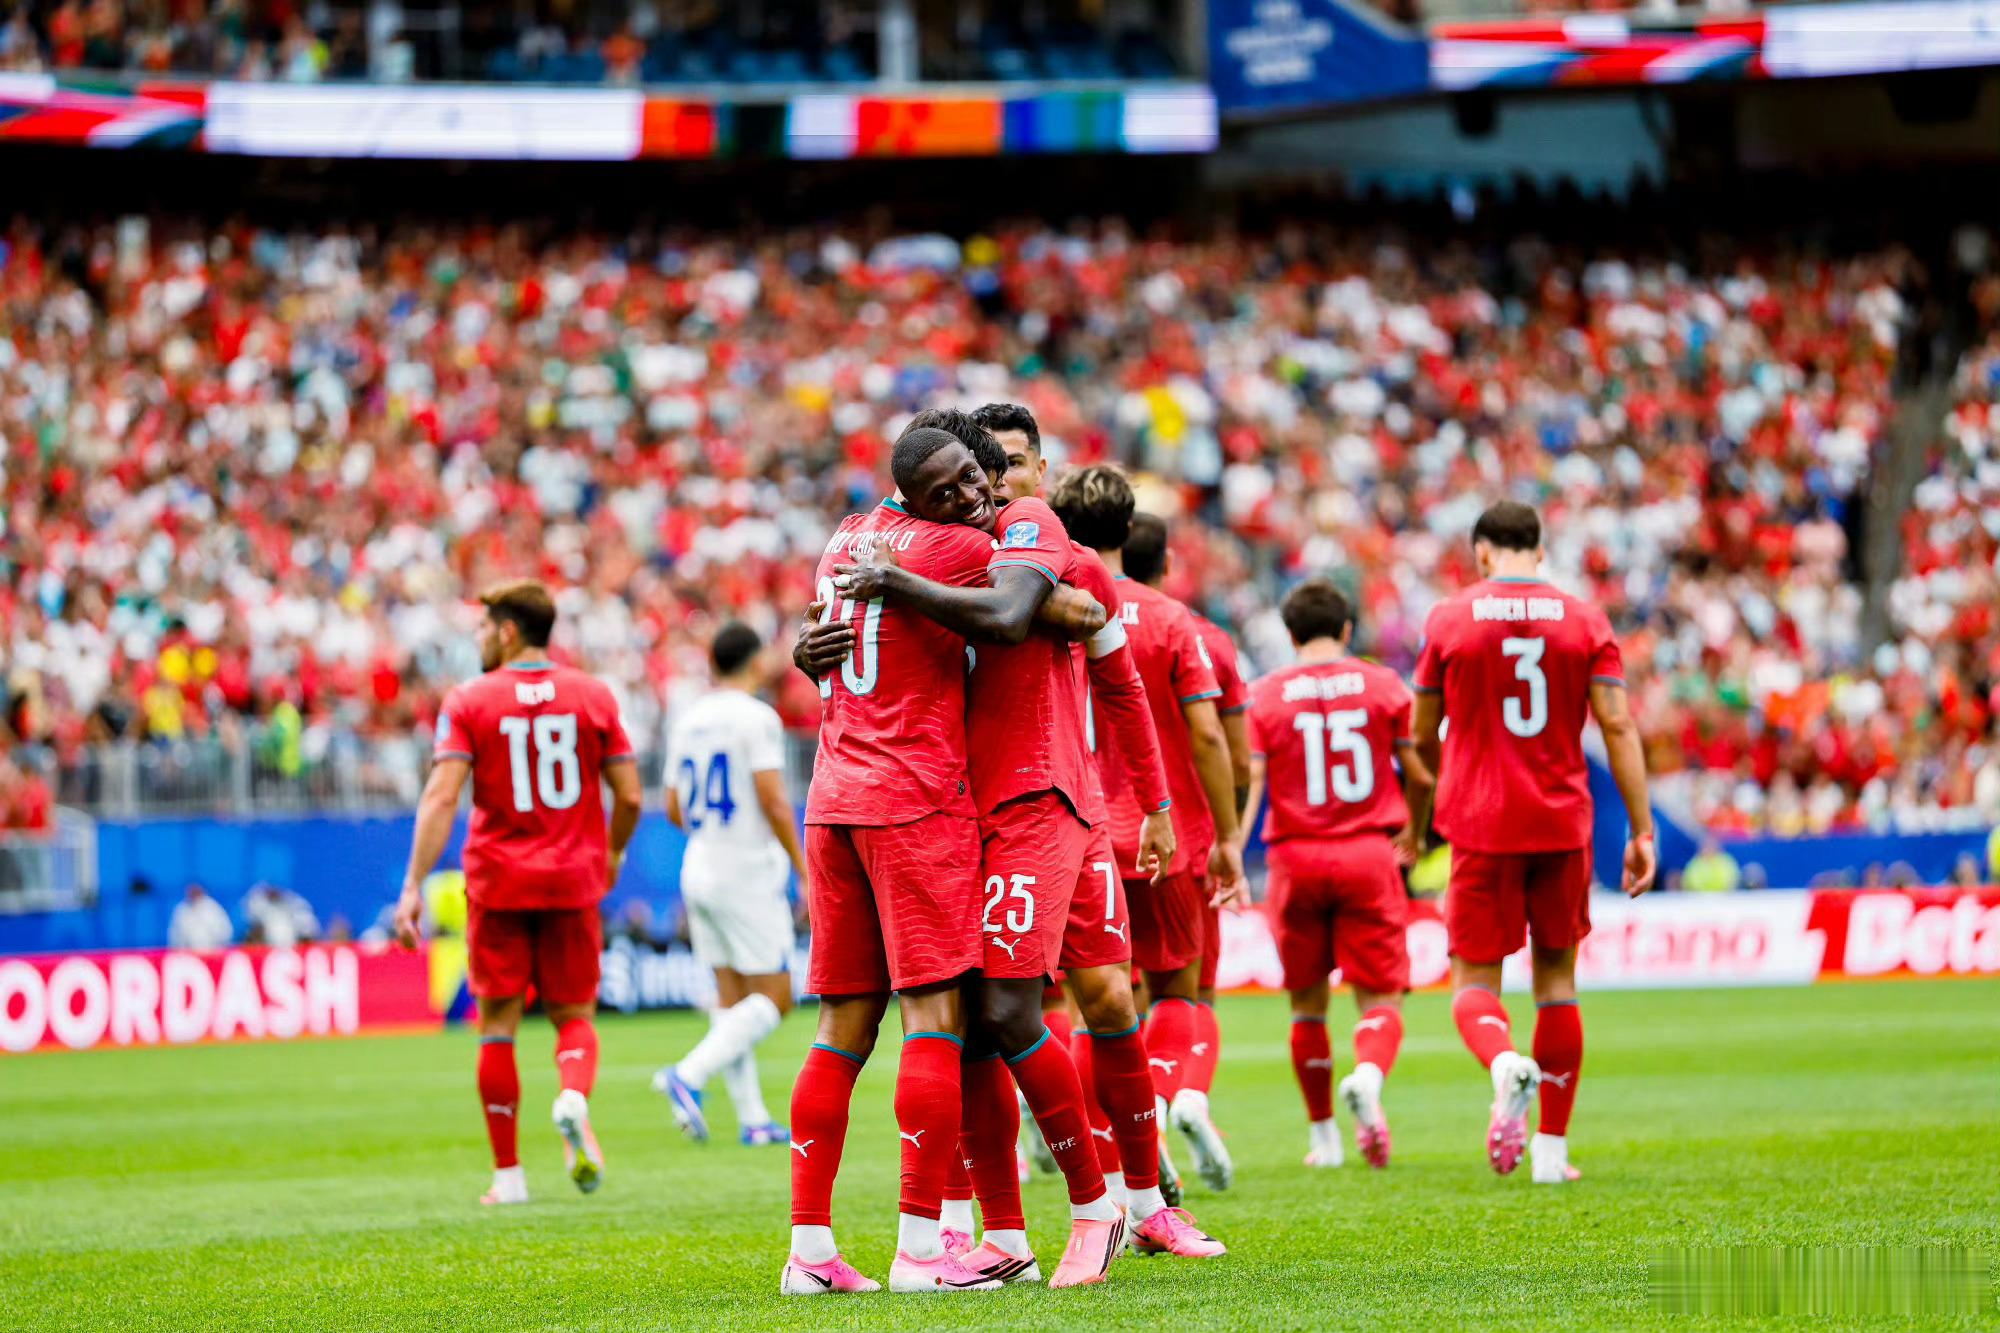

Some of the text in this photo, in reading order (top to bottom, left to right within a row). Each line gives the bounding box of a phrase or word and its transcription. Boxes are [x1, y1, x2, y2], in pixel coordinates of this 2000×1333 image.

[817, 575, 884, 700] 20
[1501, 634, 1549, 739] 3
[498, 712, 582, 813] 18
[680, 752, 736, 829] 24
[1292, 706, 1375, 807] 15
[982, 873, 1037, 934] 25
[1092, 861, 1116, 921] 7
[1572, 914, 1770, 976] etano
